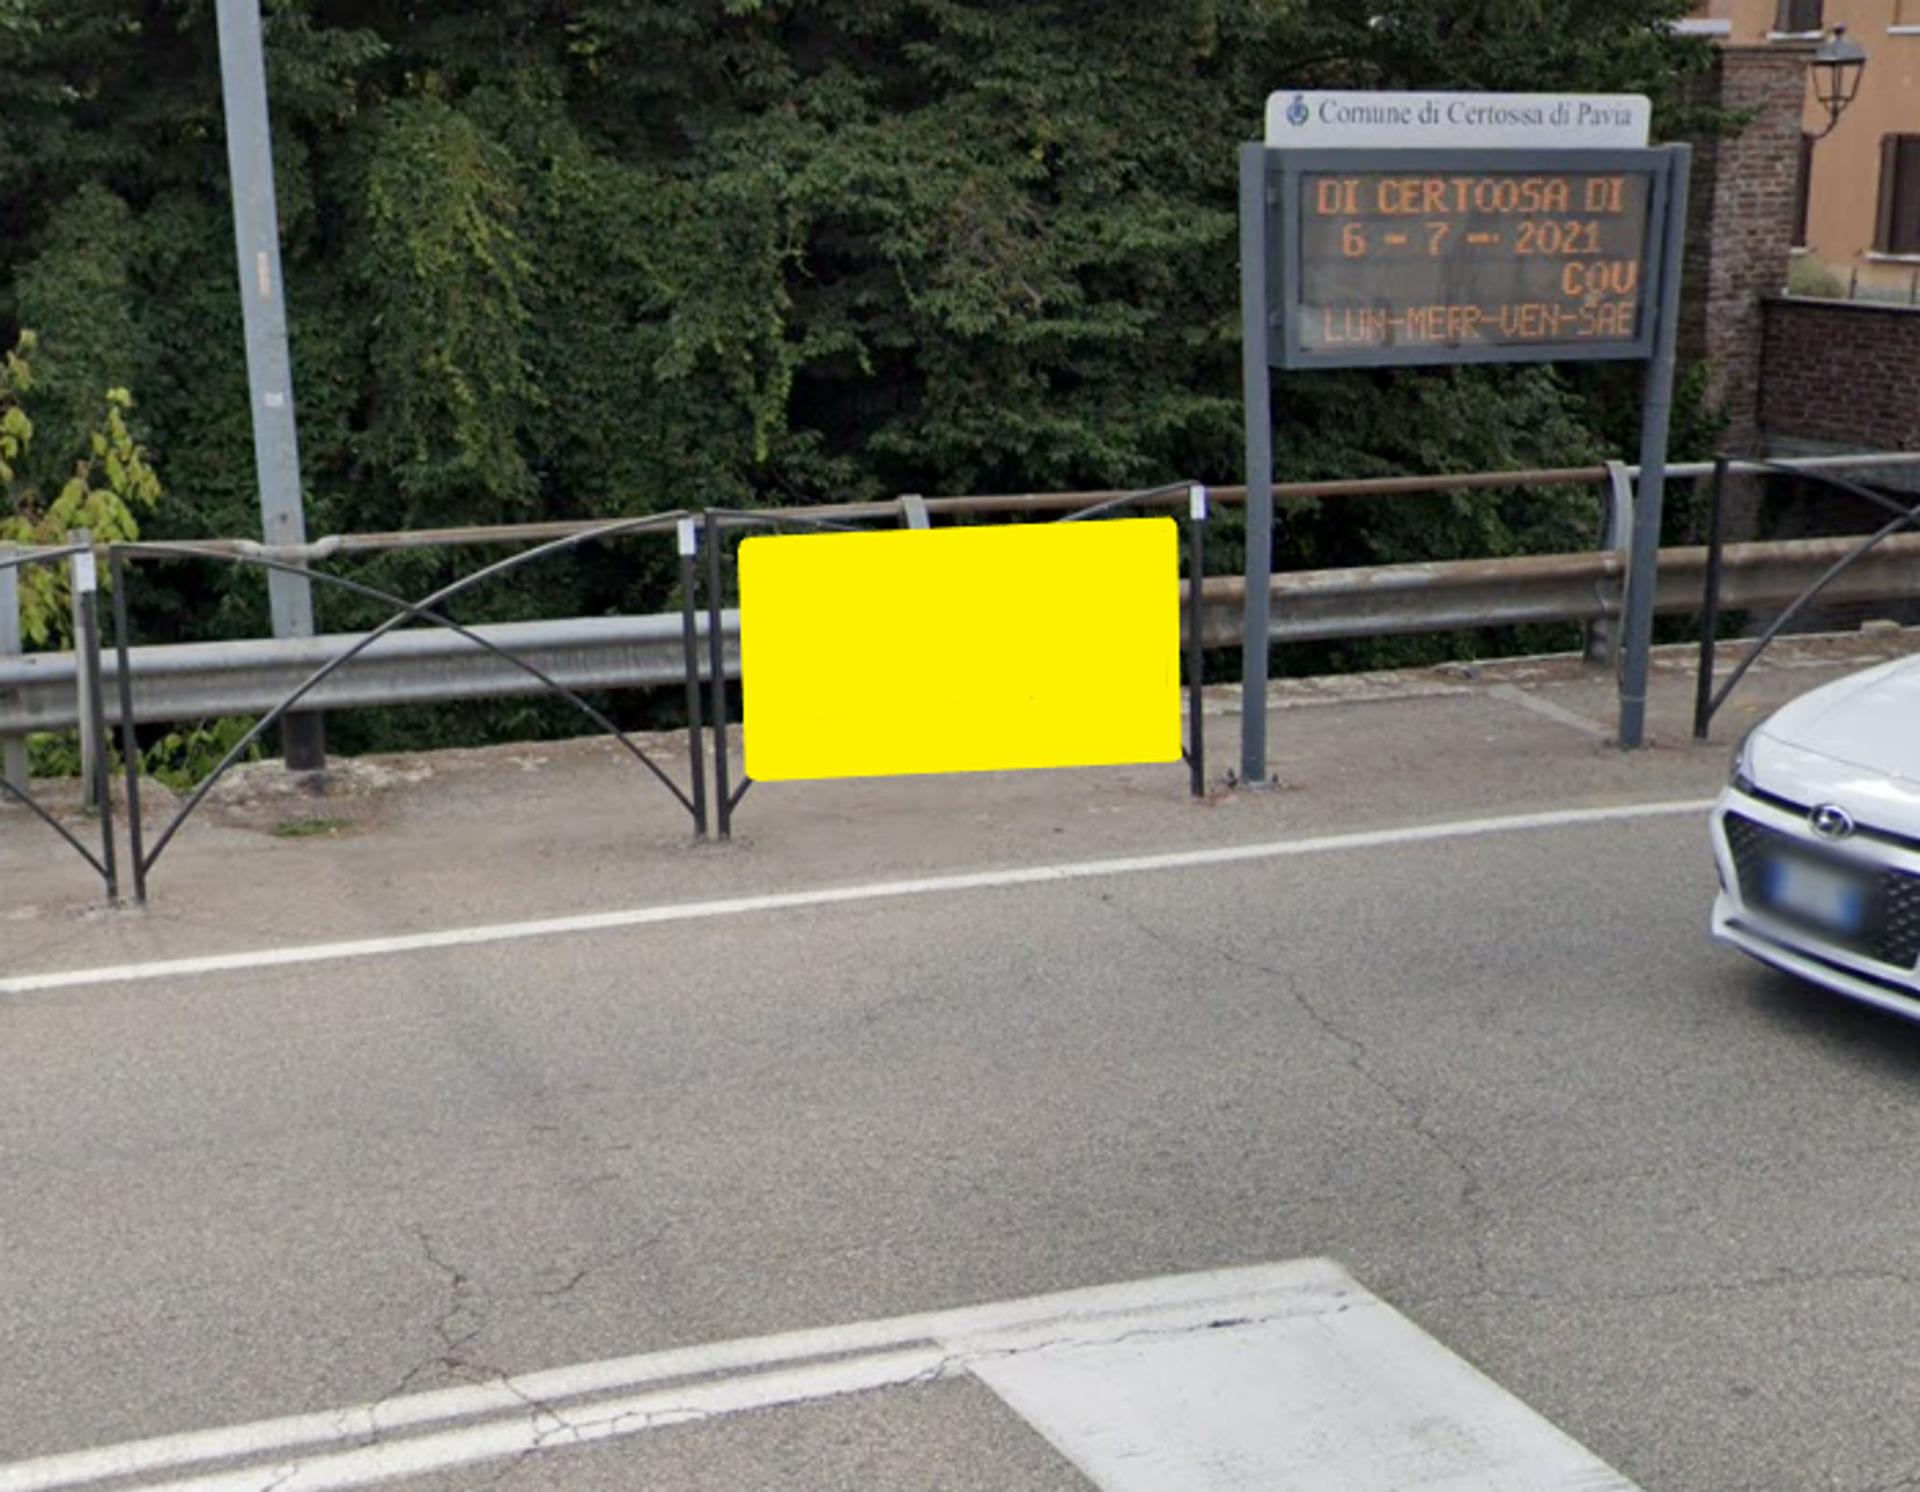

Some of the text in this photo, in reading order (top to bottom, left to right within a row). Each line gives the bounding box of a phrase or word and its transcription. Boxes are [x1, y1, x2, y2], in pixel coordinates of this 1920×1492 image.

[1319, 100, 1412, 125] Comune
[1418, 101, 1439, 125] di
[1550, 103, 1570, 126] di
[1576, 105, 1632, 126] Pavia
[1317, 179, 1359, 215] DI
[1585, 178, 1625, 212] DI
[1342, 223, 1366, 257] 6
[1427, 222, 1450, 256] 7
[1515, 220, 1601, 254] 2021
